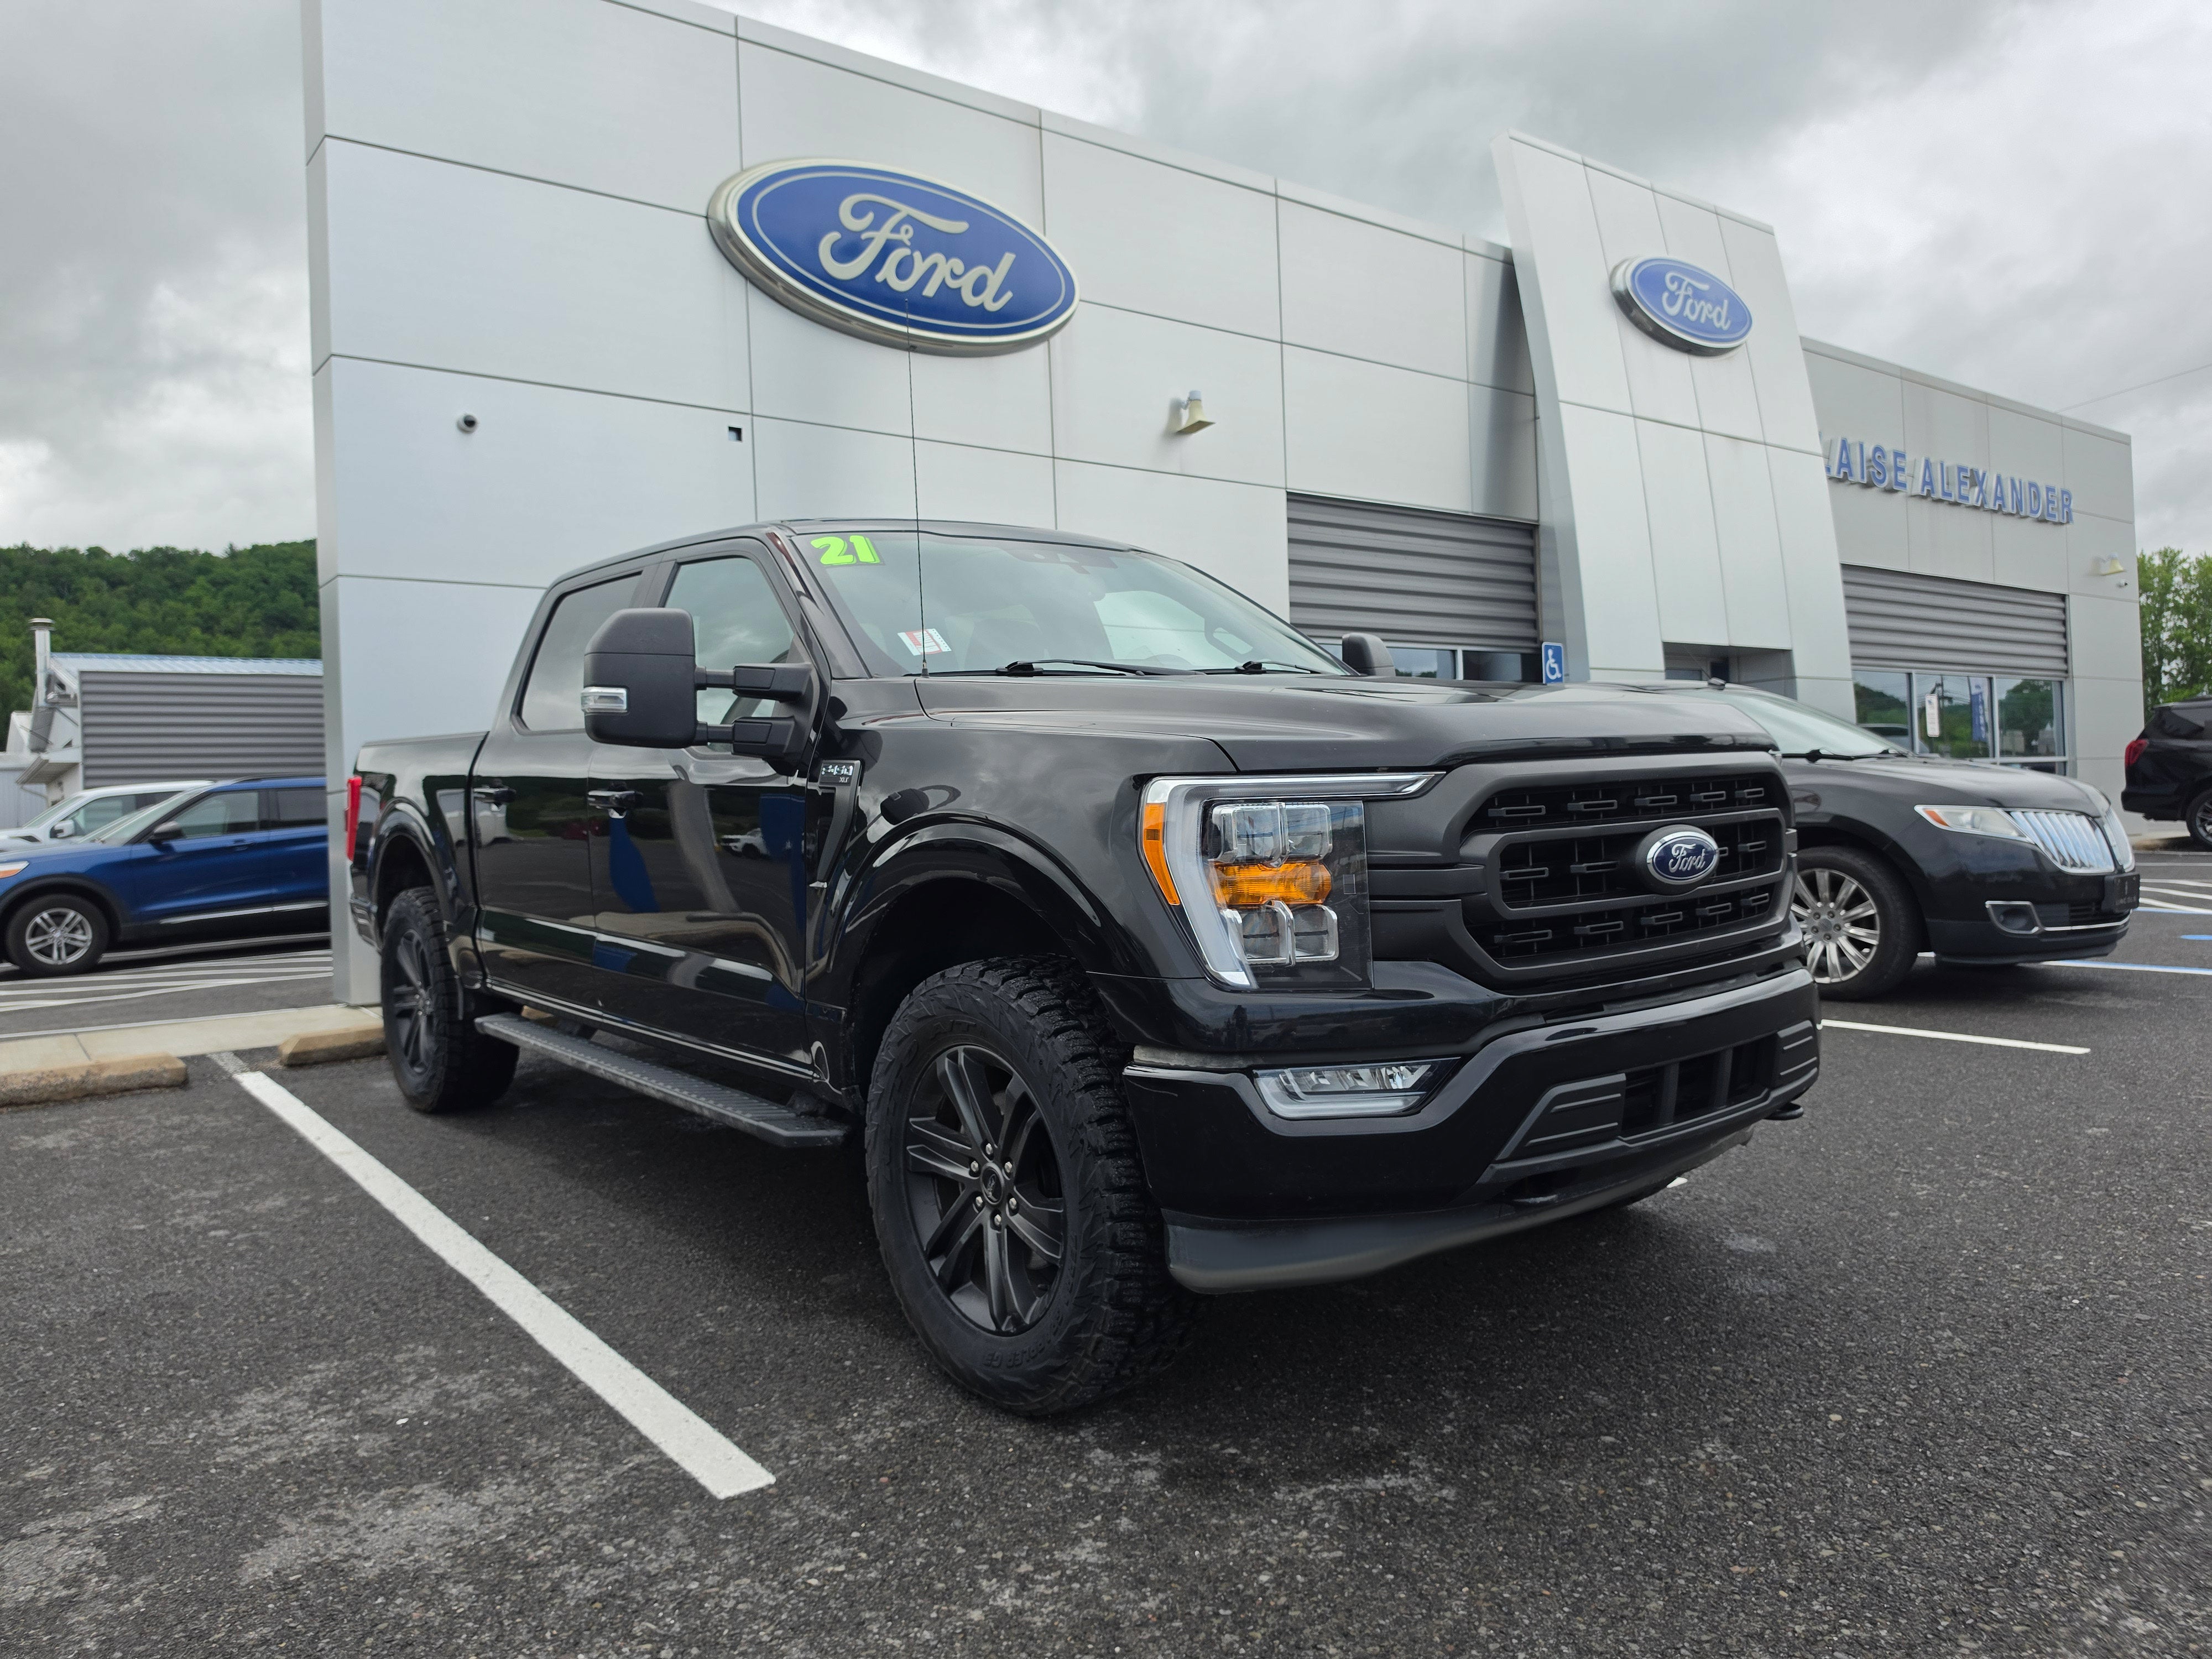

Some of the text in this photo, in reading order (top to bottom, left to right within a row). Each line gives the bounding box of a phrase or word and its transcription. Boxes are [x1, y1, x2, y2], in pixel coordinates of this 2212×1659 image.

[818, 193, 1018, 312] Ford
[1662, 271, 1731, 331] Ford
[1824, 437, 2074, 524] AISE ALEXANDER
[811, 535, 880, 565] 21
[1668, 843, 1707, 873] Ford
